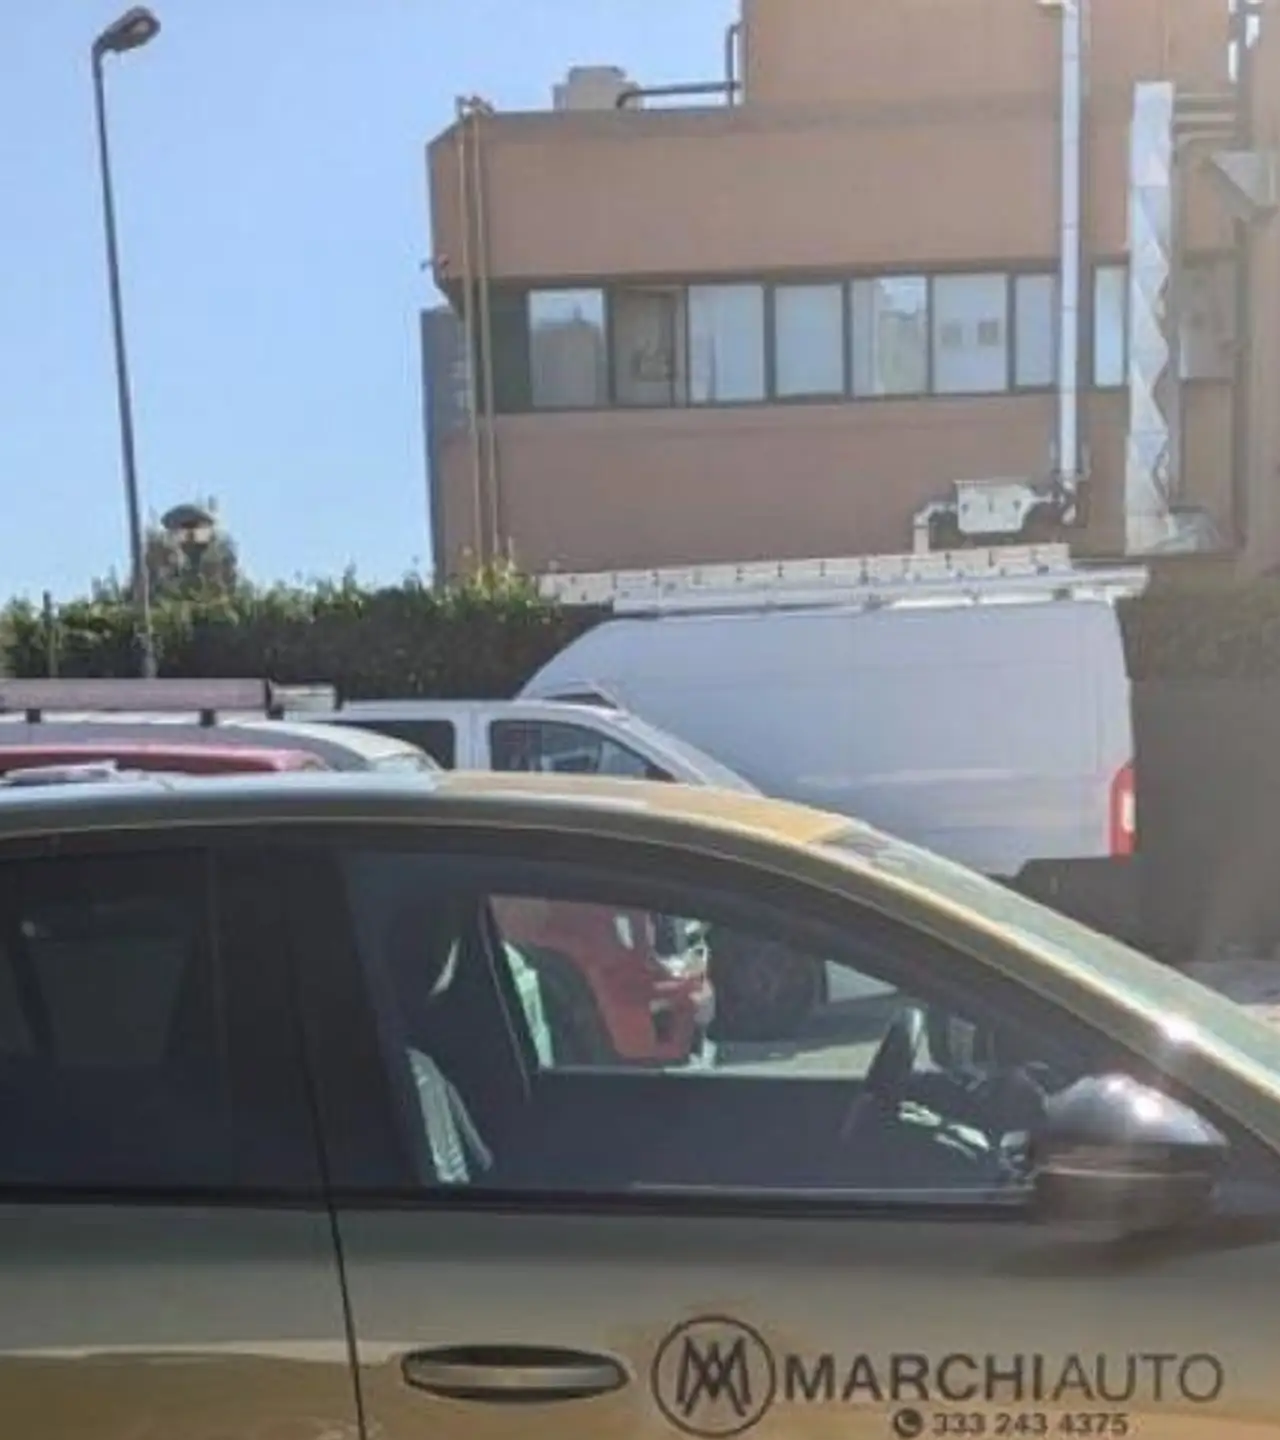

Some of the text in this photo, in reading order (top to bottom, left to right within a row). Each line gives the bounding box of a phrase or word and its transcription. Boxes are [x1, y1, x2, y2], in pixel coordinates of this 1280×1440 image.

[932, 1412, 1129, 1436] 333 243 4375
